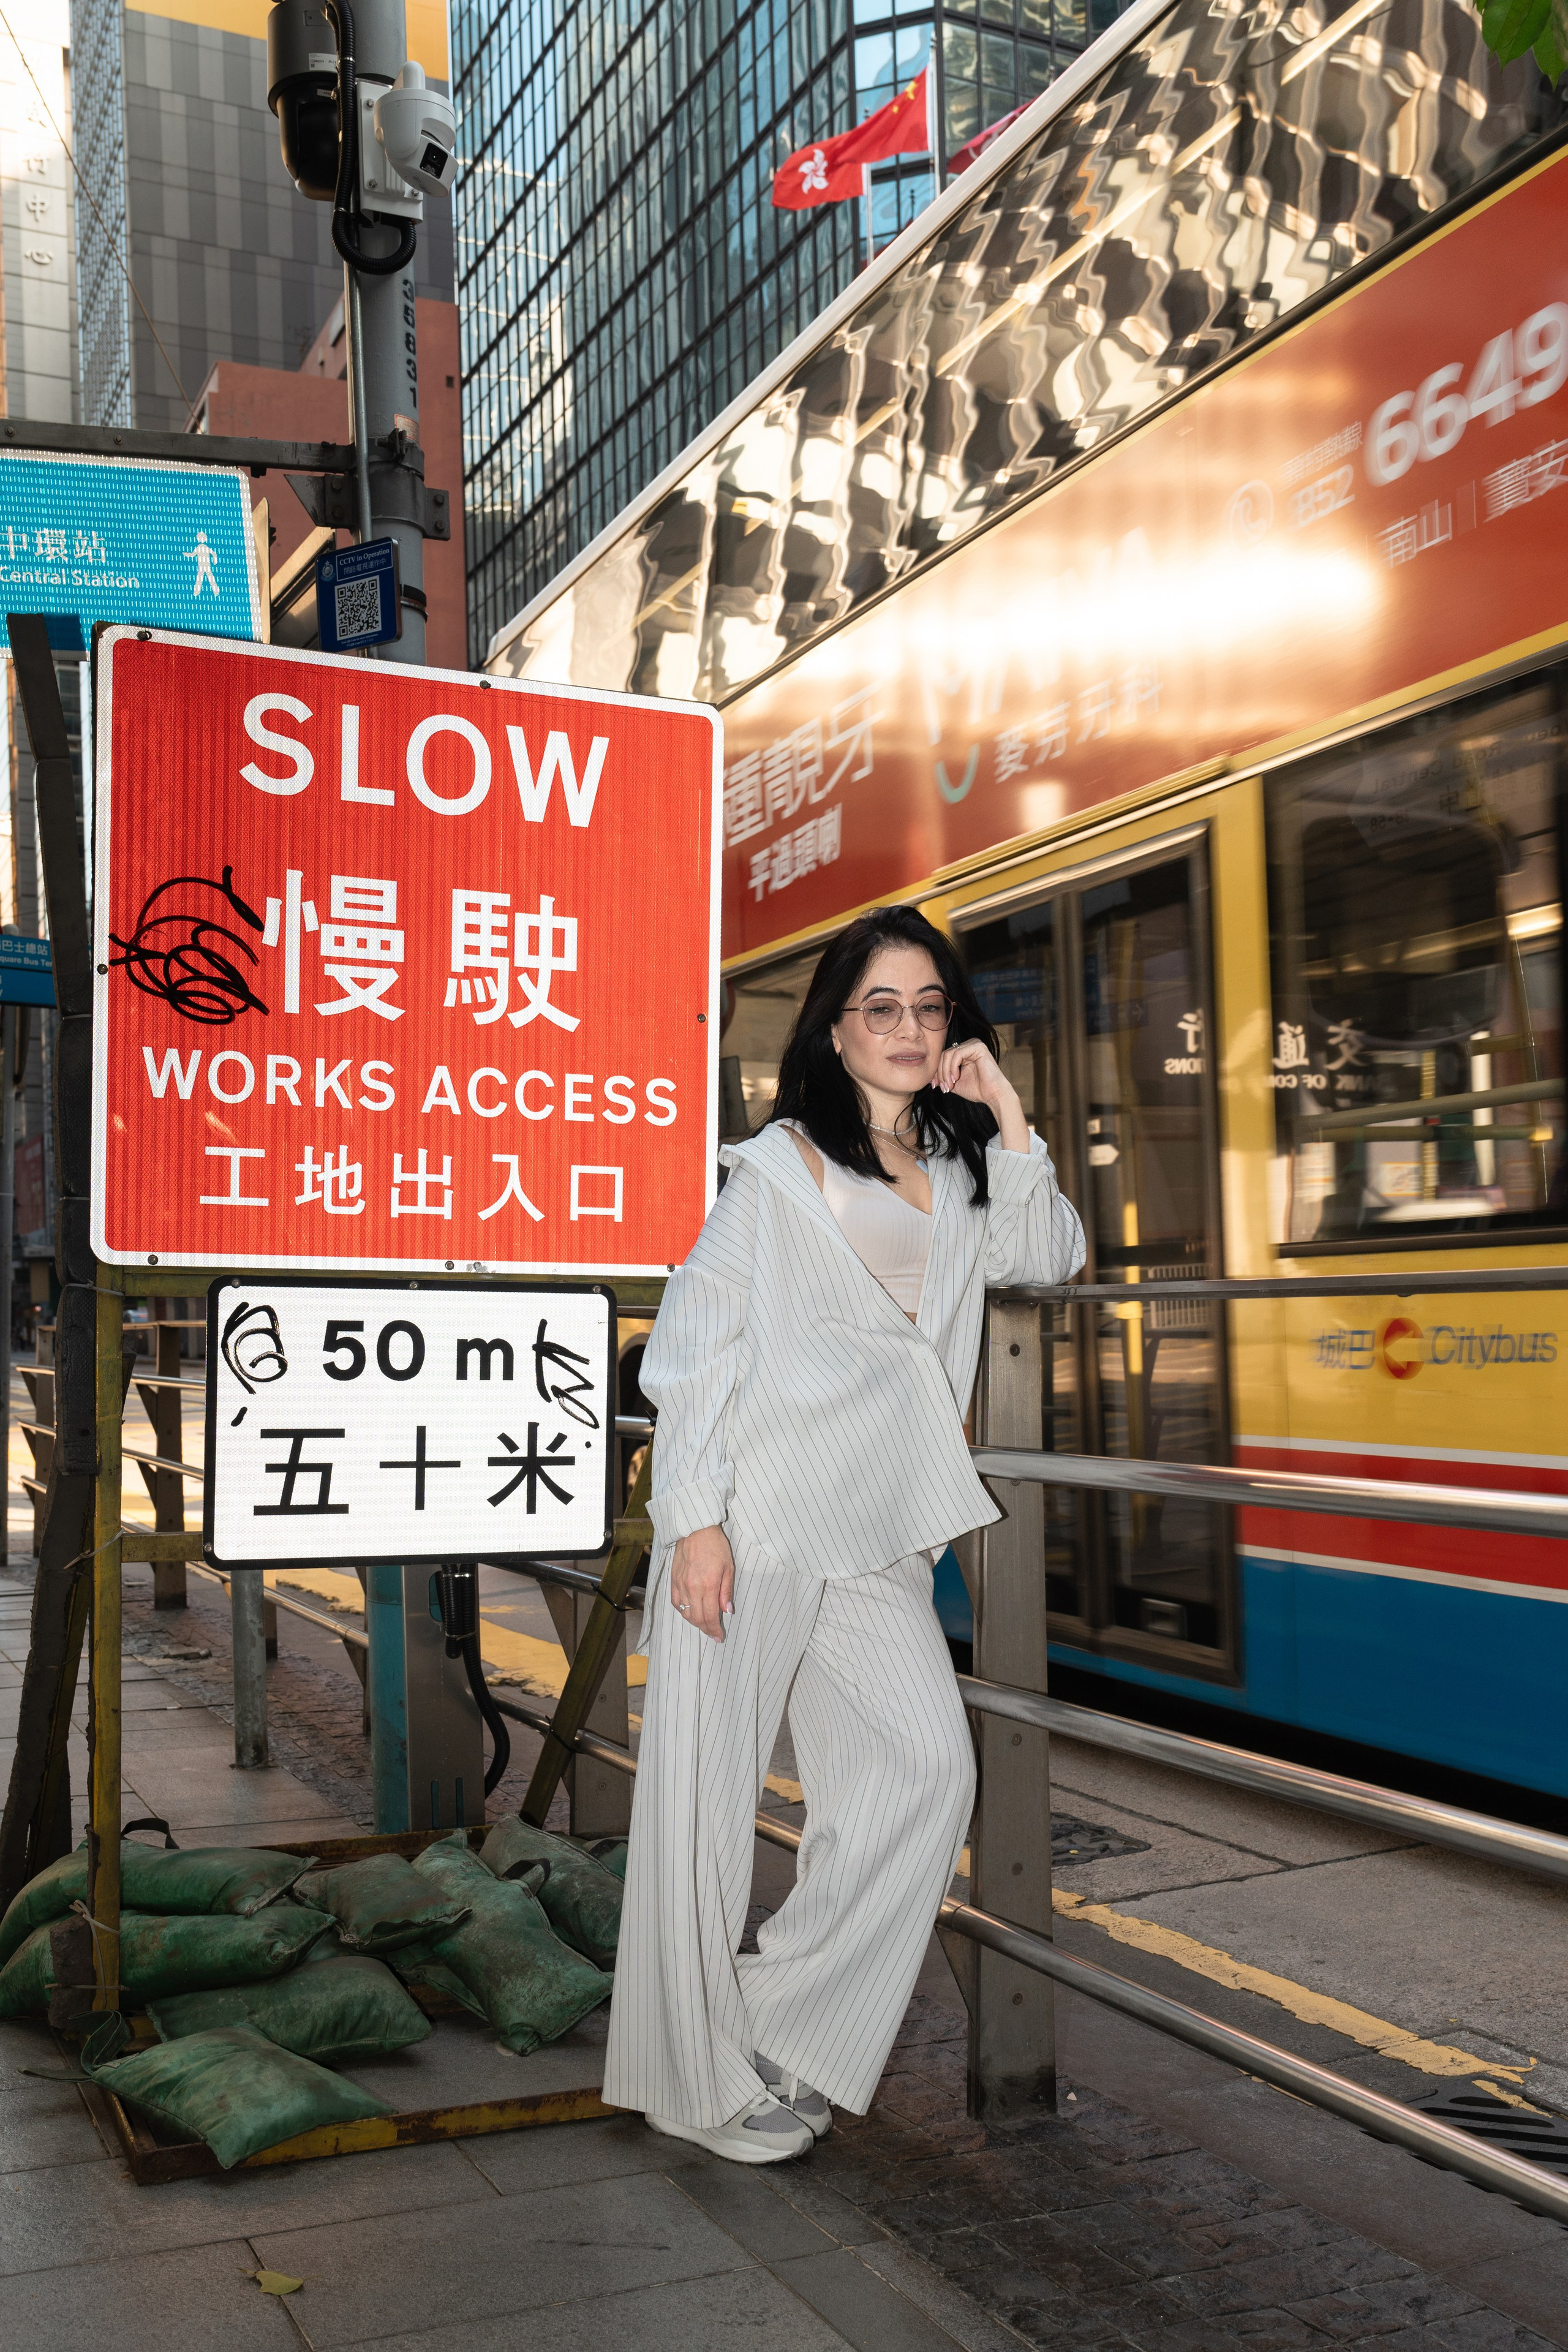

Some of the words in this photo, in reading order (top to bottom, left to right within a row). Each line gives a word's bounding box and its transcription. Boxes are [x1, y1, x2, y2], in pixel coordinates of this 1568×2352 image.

[1364, 302, 1568, 487] 6649
[1289, 464, 1355, 530] 852
[0, 525, 106, 564] 中環站
[339, 556, 356, 566] CCTV
[363, 548, 390, 560] Operation
[343, 557, 386, 575] 閉路電視運作中
[1374, 499, 1453, 570] 南山
[72, 569, 140, 589] Station
[238, 692, 610, 828] SLOW
[0, 940, 48, 956] 巴士總站
[262, 868, 581, 1033] 慢駛
[141, 1046, 396, 1112] WORKS
[420, 1065, 679, 1126] ACCESS
[199, 1144, 625, 1223] 工地出入口
[322, 1319, 426, 1381] 50
[456, 1336, 514, 1381] m
[1314, 1328, 1376, 1370] 城巴
[1429, 1324, 1559, 1370] Citybus
[253, 1421, 576, 1517] 五十米
